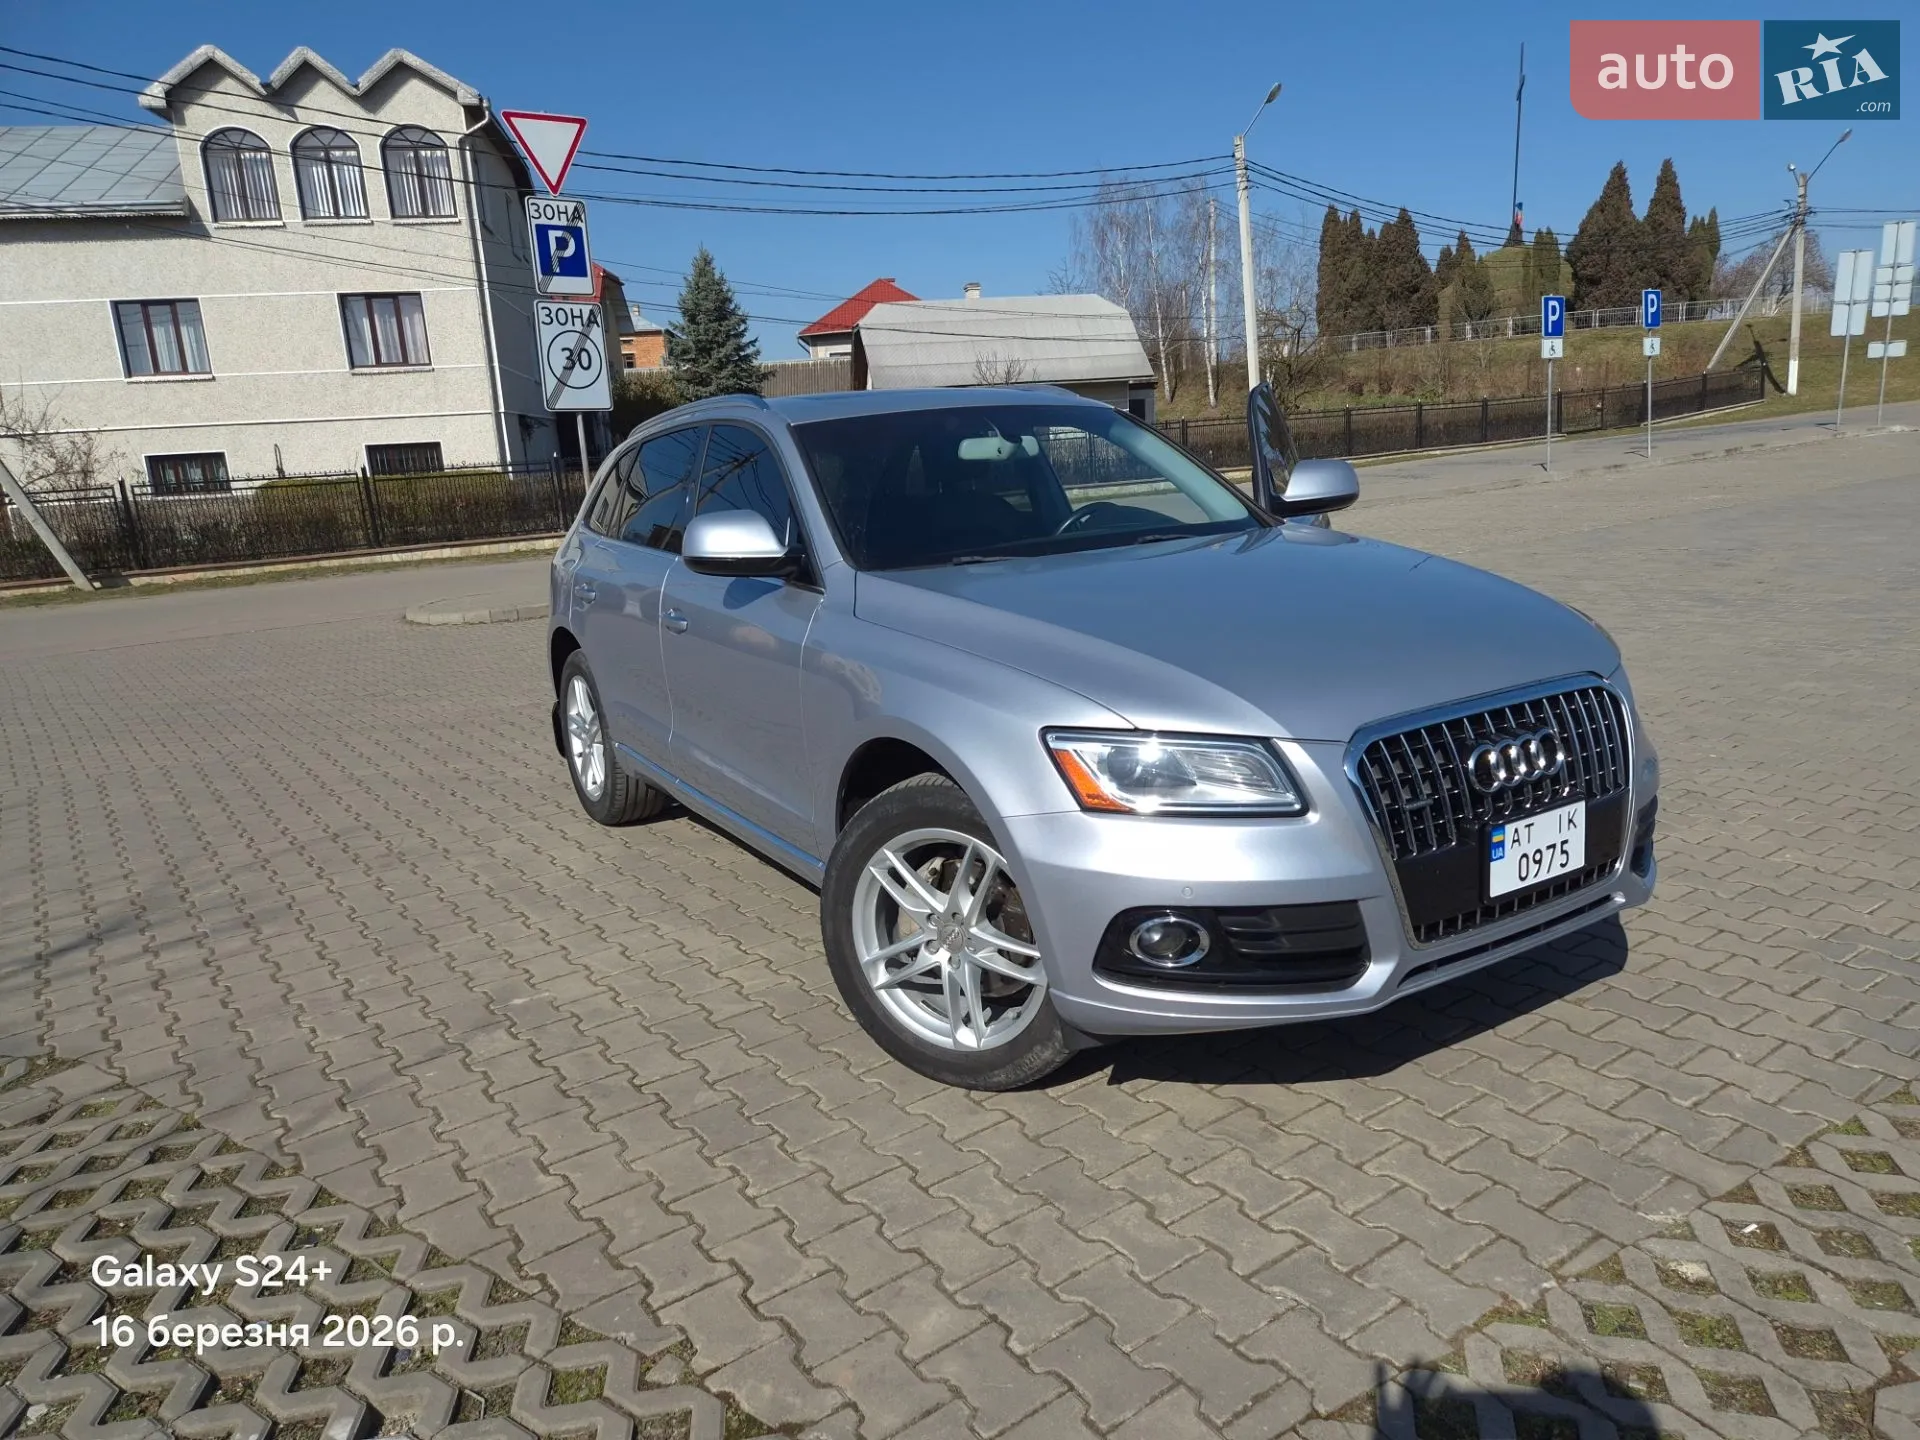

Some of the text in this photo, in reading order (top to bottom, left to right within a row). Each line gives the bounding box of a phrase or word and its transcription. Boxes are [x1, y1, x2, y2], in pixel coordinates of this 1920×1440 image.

[530, 202, 584, 223] ЗОНА
[548, 229, 576, 273] P
[541, 306, 600, 328] ЗОНА
[1548, 300, 1560, 332] P
[1647, 294, 1658, 323] P
[561, 347, 592, 371] 30
[1511, 823, 1534, 848] AT
[1492, 847, 1504, 859] UA
[1518, 839, 1569, 881] 0975
